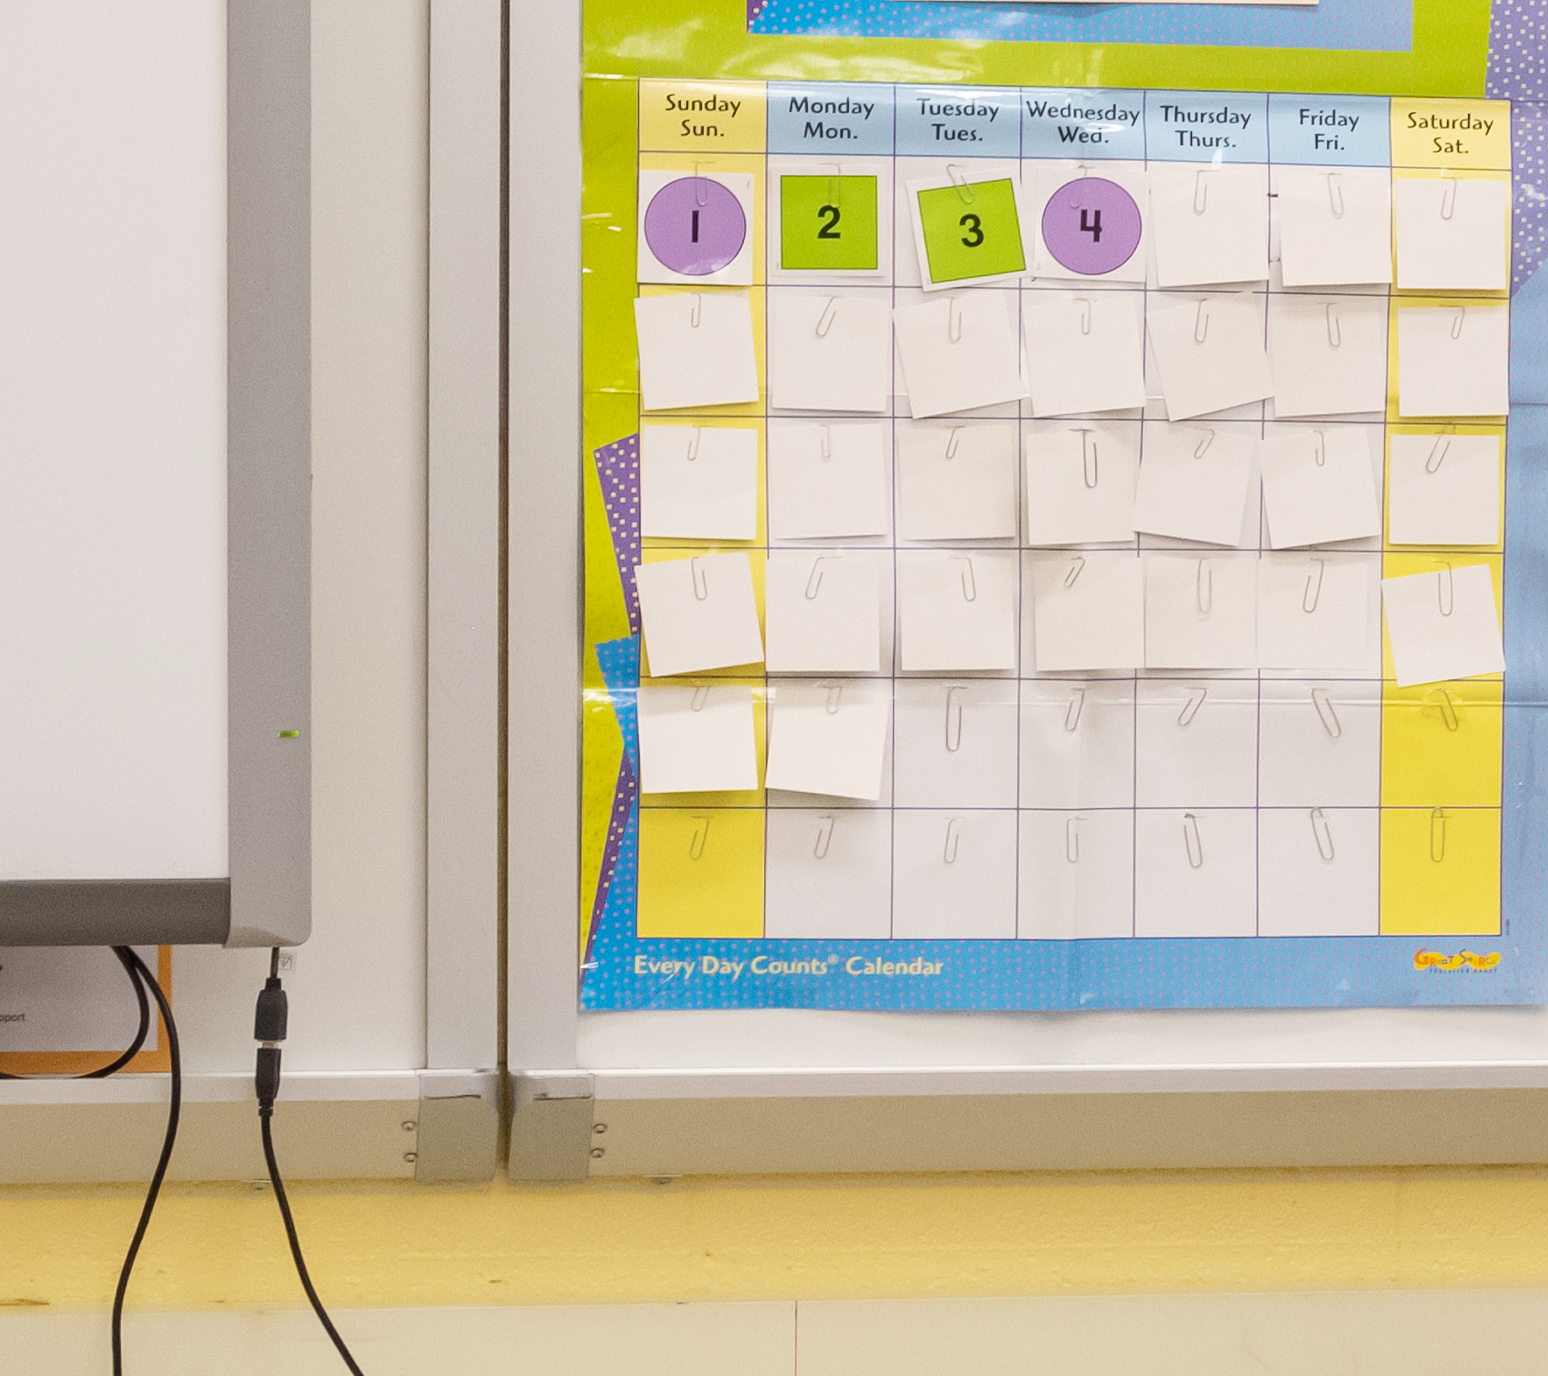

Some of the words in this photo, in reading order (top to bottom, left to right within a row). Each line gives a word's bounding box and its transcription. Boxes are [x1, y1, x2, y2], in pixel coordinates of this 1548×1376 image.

[664, 93, 742, 119] Sunday
[787, 95, 876, 121] Monday
[920, 101, 1000, 124] Tuesday
[1027, 99, 1141, 128] Wednesday
[1158, 104, 1253, 131] Thursday
[679, 118, 725, 138] Sun.
[802, 120, 858, 140] Mon.
[930, 122, 984, 143] Tues.
[1298, 107, 1361, 133] Friday
[1407, 110, 1495, 137] Saturday
[1056, 125, 1109, 145] Wed.
[1173, 129, 1237, 148] Thurs.
[1313, 132, 1345, 151] Fri.
[1432, 136, 1469, 155] Sat.
[690, 209, 700, 244] 1
[817, 204, 842, 240] 2
[958, 213, 985, 249] 3
[1079, 208, 1103, 243] 4
[633, 954, 696, 979] Every
[701, 955, 746, 982] Day
[845, 955, 945, 975] Calendar
